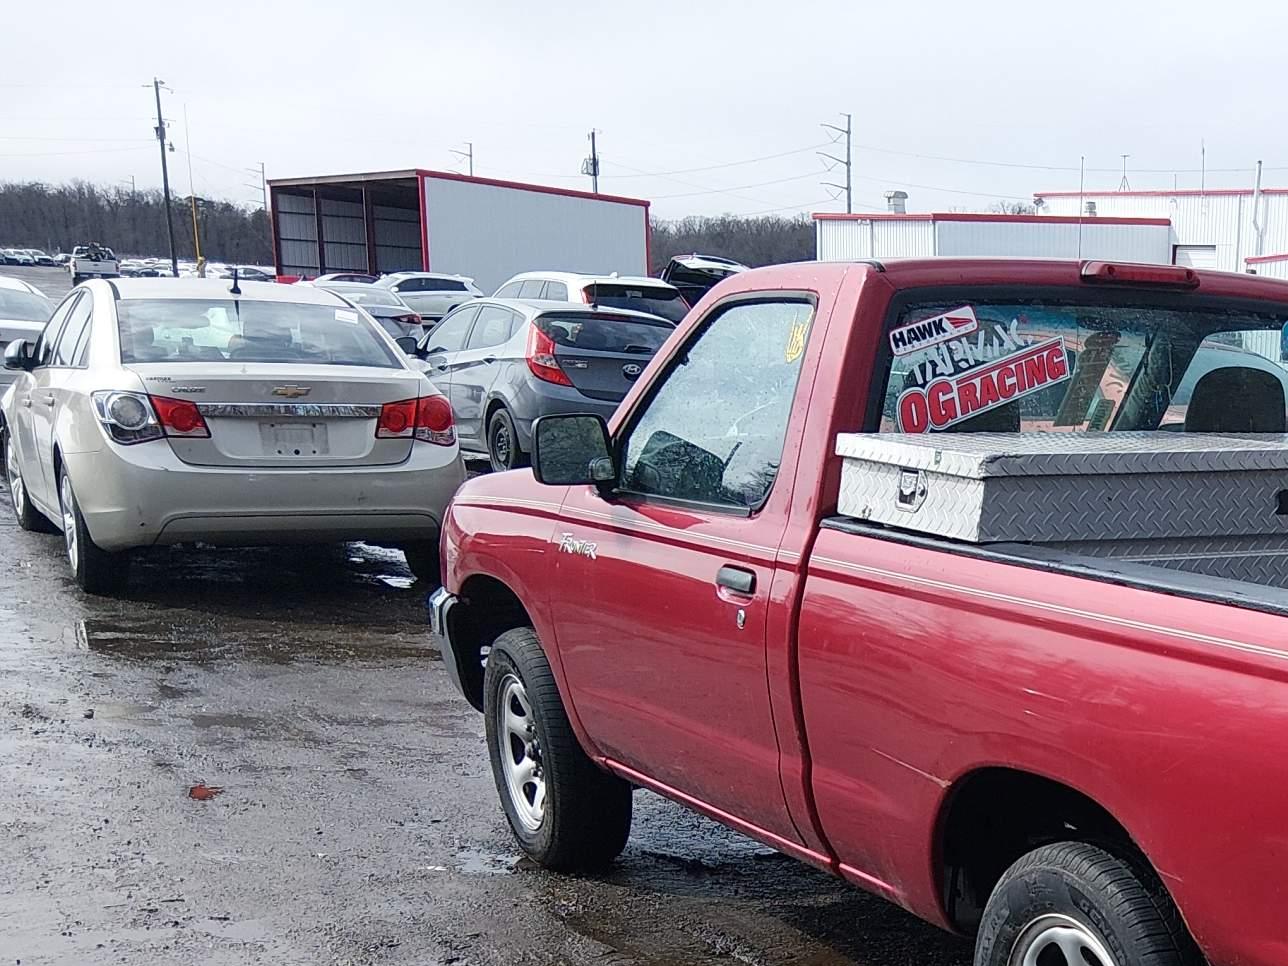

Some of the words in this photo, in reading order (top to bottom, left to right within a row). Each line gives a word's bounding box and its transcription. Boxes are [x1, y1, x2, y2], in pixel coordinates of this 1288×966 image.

[892, 317, 948, 349] HAWK
[900, 379, 957, 433] OG
[956, 347, 1067, 416] RACING
